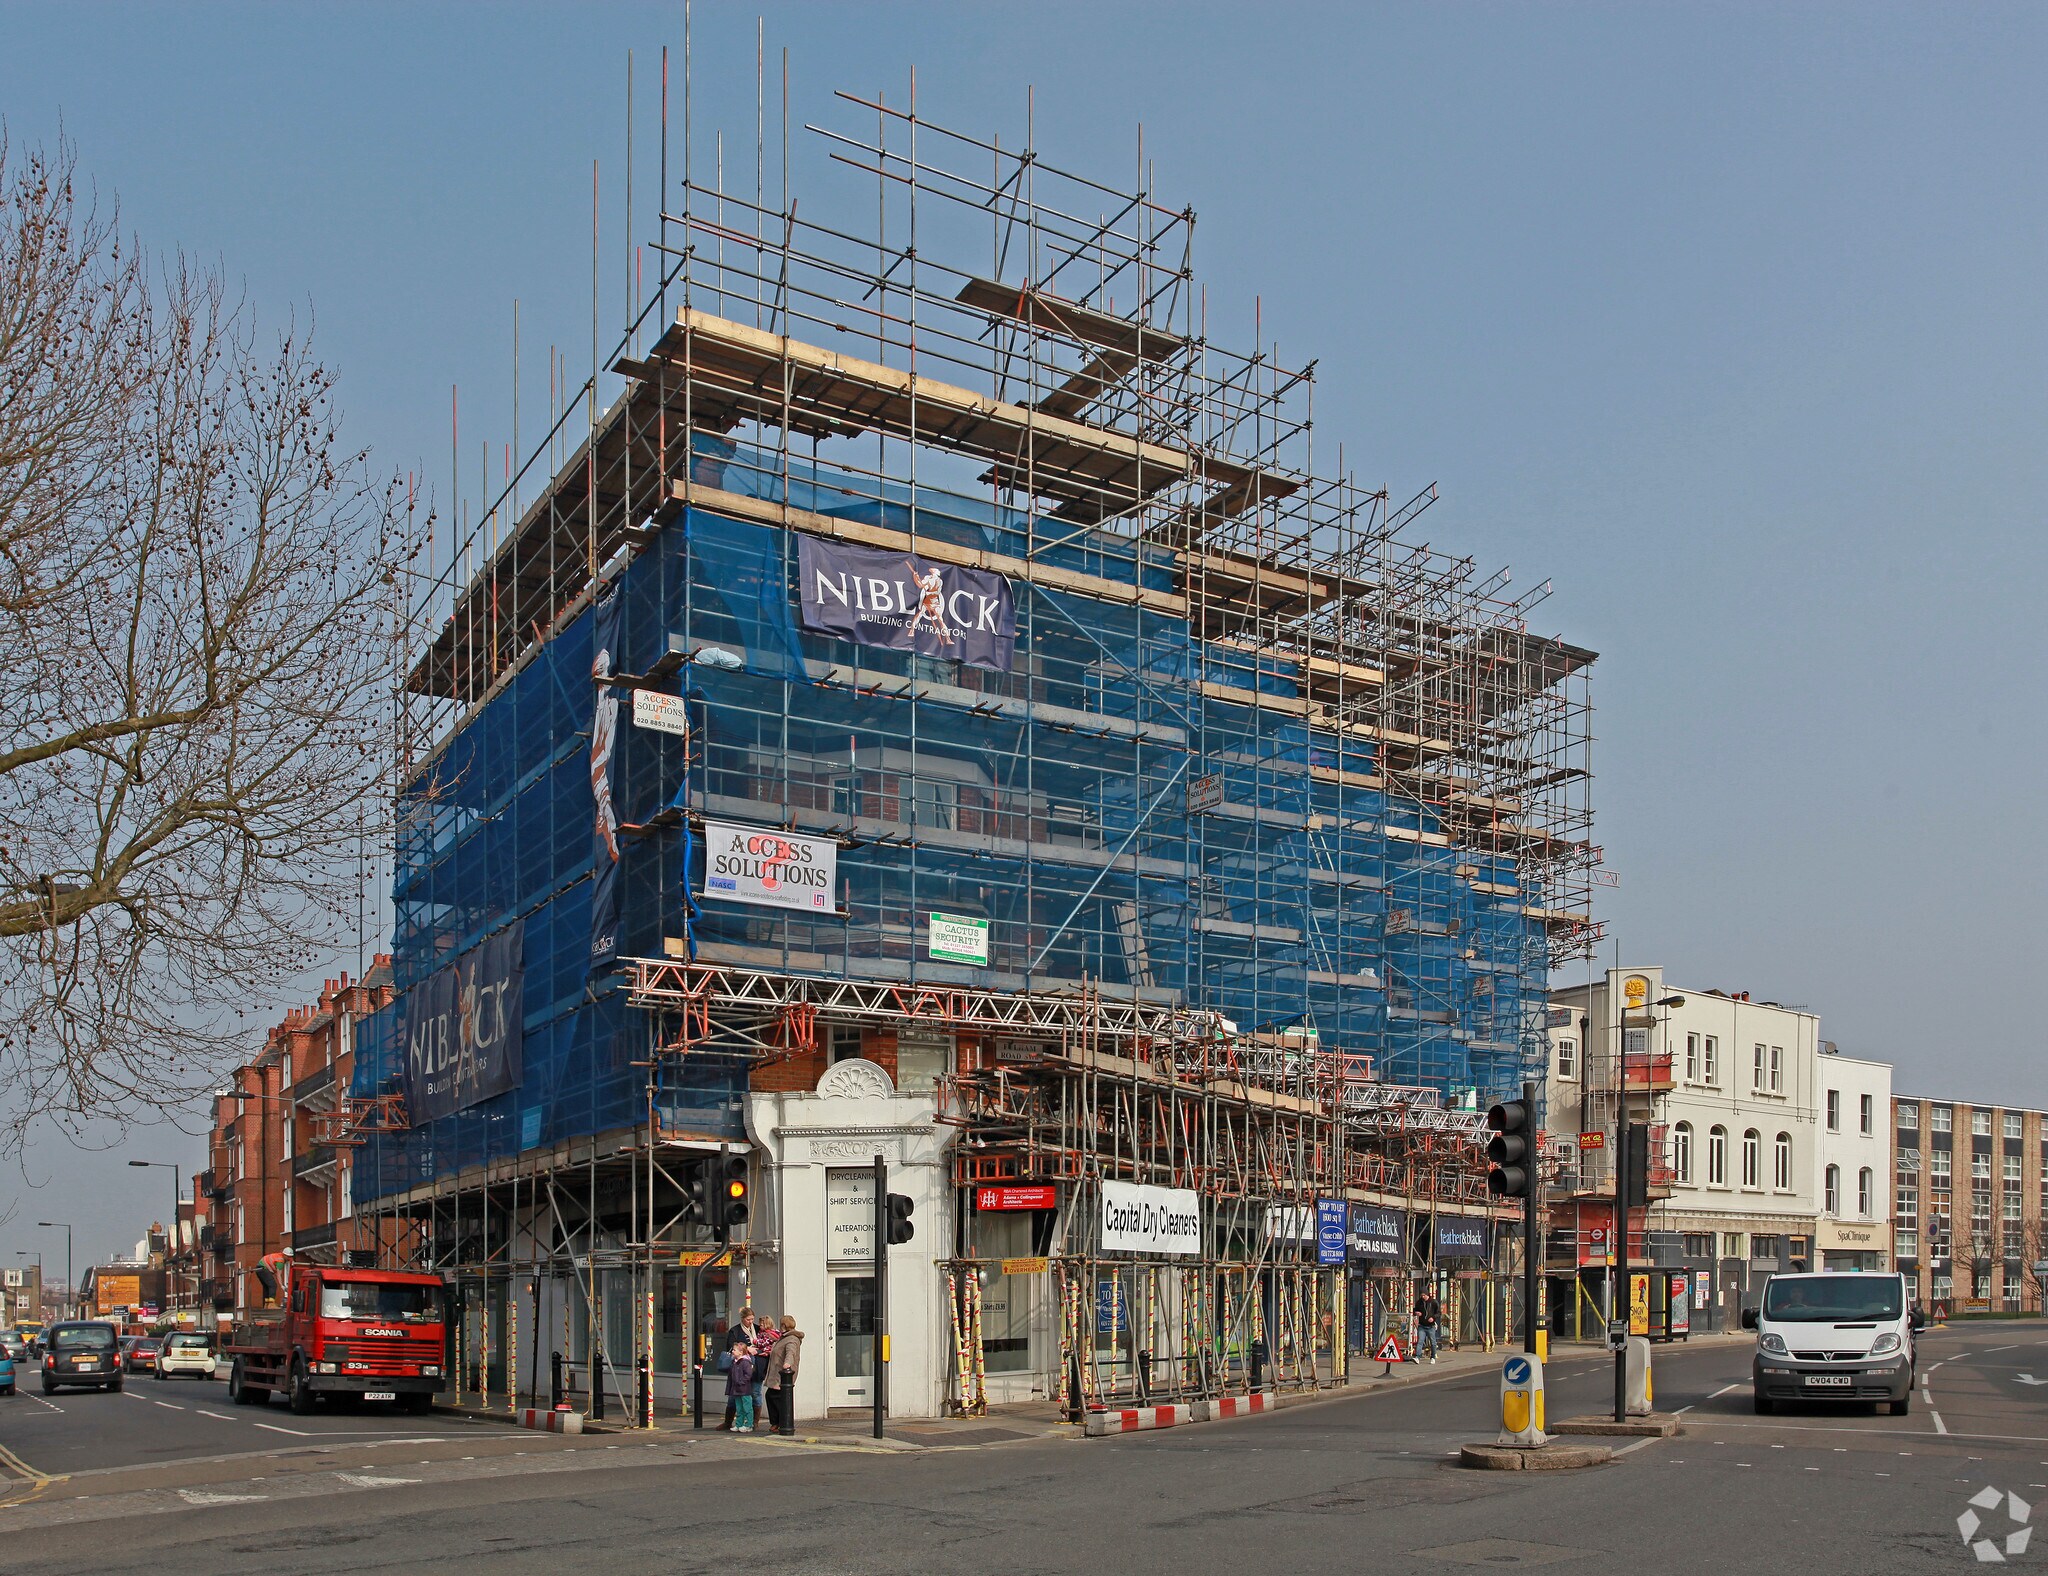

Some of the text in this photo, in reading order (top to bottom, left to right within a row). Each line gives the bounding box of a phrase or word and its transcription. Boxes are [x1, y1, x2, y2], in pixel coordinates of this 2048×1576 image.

[816, 568, 1000, 636] NIBLOCK
[860, 613, 903, 628] BUILDING
[643, 694, 677, 707] ACCESS
[636, 702, 683, 717] SOLUTIONS
[636, 717, 649, 725] 020
[729, 834, 813, 863] ACCESS
[714, 854, 828, 888] SOLUTIONS
[711, 880, 732, 890] NASC
[944, 924, 979, 937] CACTUS
[935, 932, 980, 947] SECURITY
[410, 976, 510, 1082] NIBLOCK
[1000, 1052, 1022, 1060] ROAD
[1319, 1202, 1345, 1213] SHOP TO LET
[1105, 1199, 1197, 1242] Capital Dry Cleaners
[1353, 1211, 1399, 1237] feather & black
[1440, 1228, 1482, 1245] feather & black
[1837, 1230, 1871, 1243] SpaClinique
[1355, 1239, 1371, 1252] OPEN
[1372, 1241, 1380, 1252] AS
[1381, 1242, 1398, 1254] USUAL
[1102, 1290, 1111, 1300] TO
